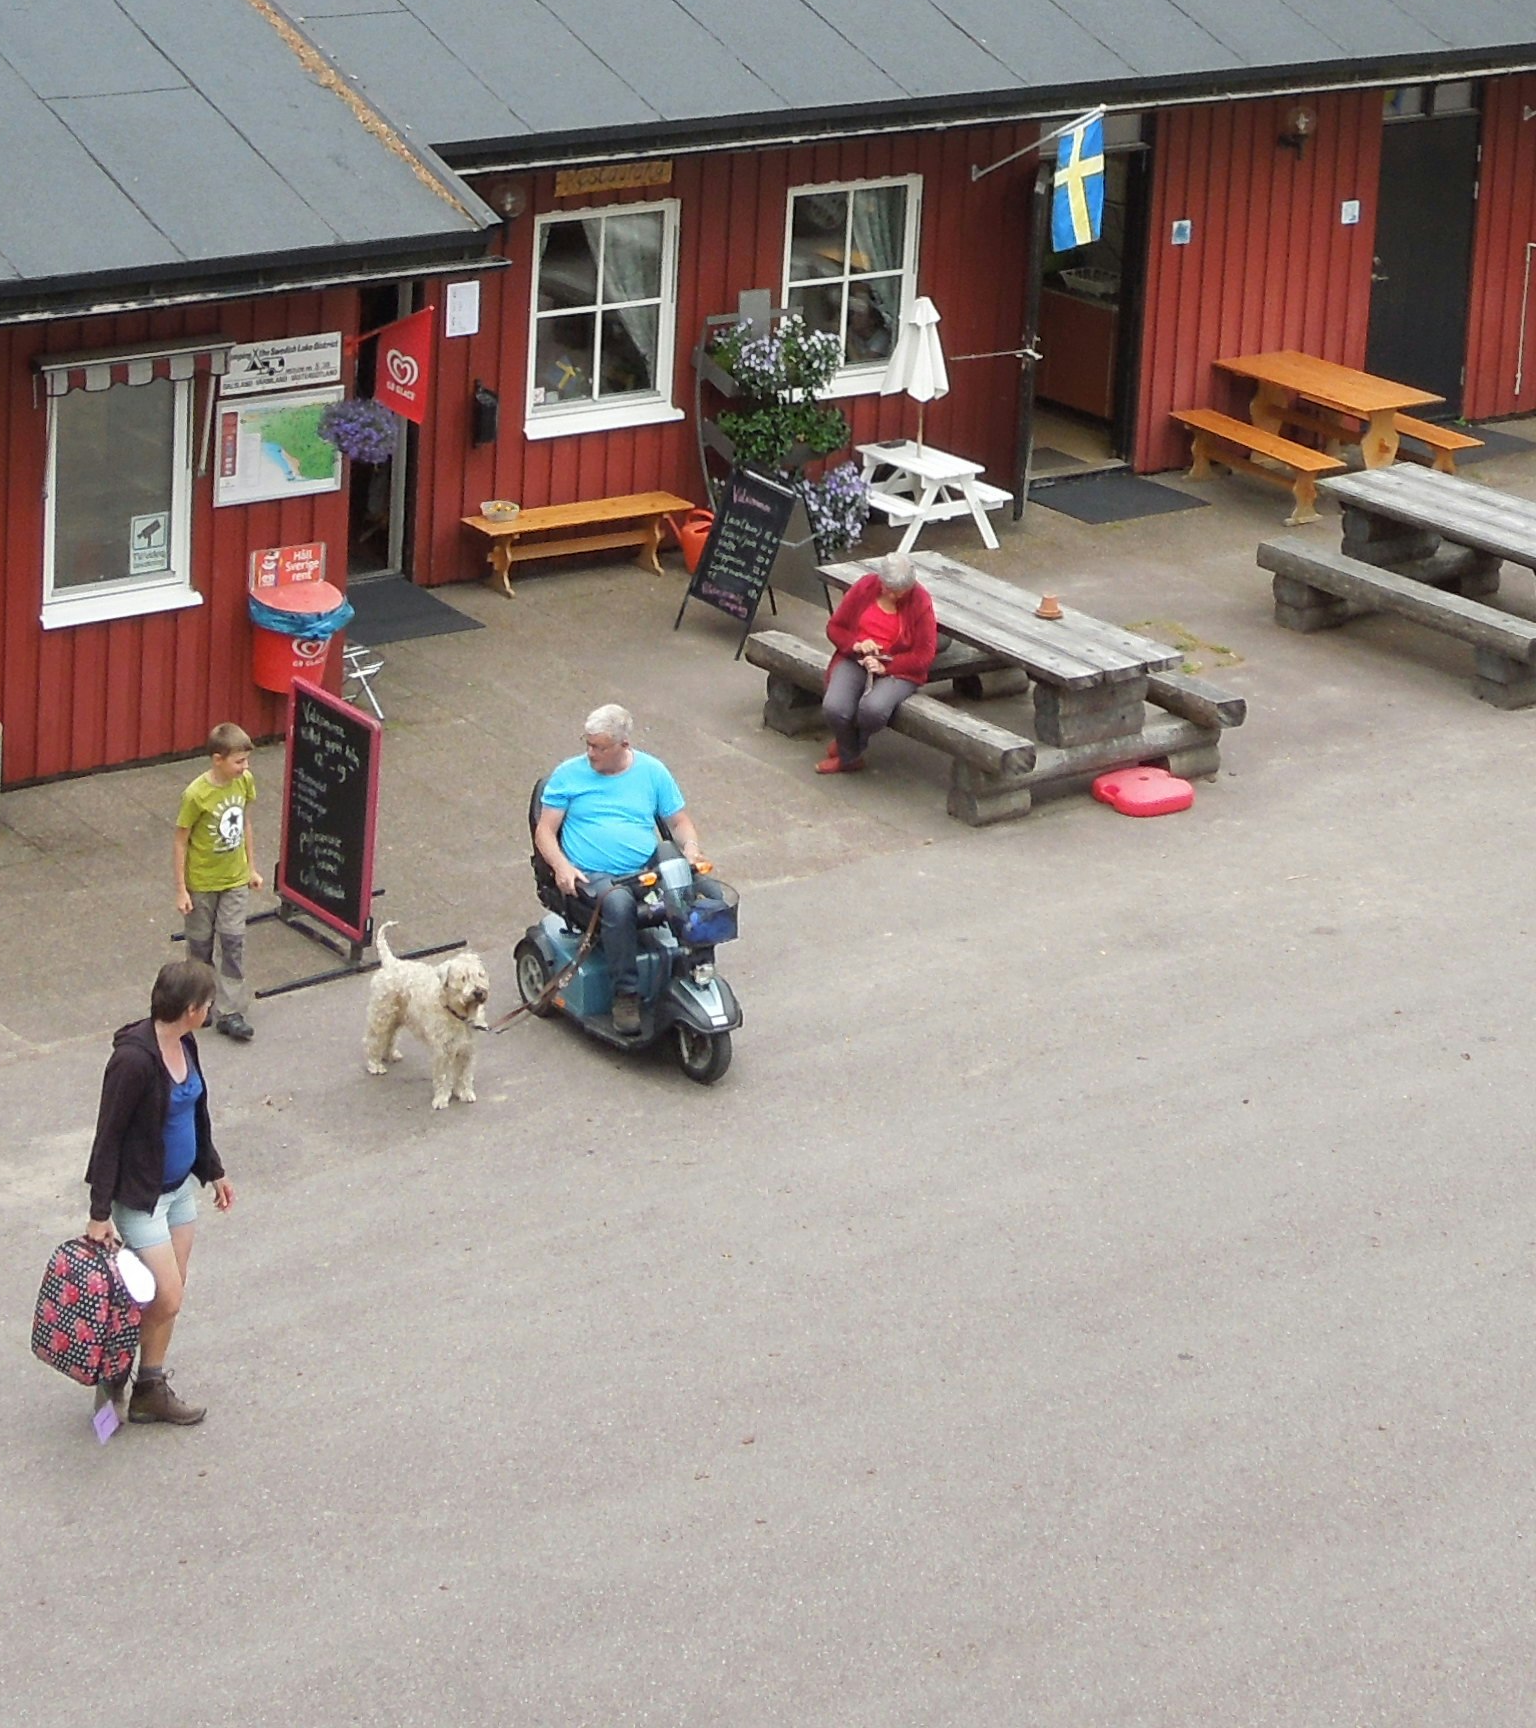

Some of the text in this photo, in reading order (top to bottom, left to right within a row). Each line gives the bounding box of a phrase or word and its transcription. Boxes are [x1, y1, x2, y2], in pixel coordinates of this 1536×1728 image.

[293, 549, 313, 561] Håll
[285, 560, 320, 572] Sverige
[292, 571, 313, 582] rent
